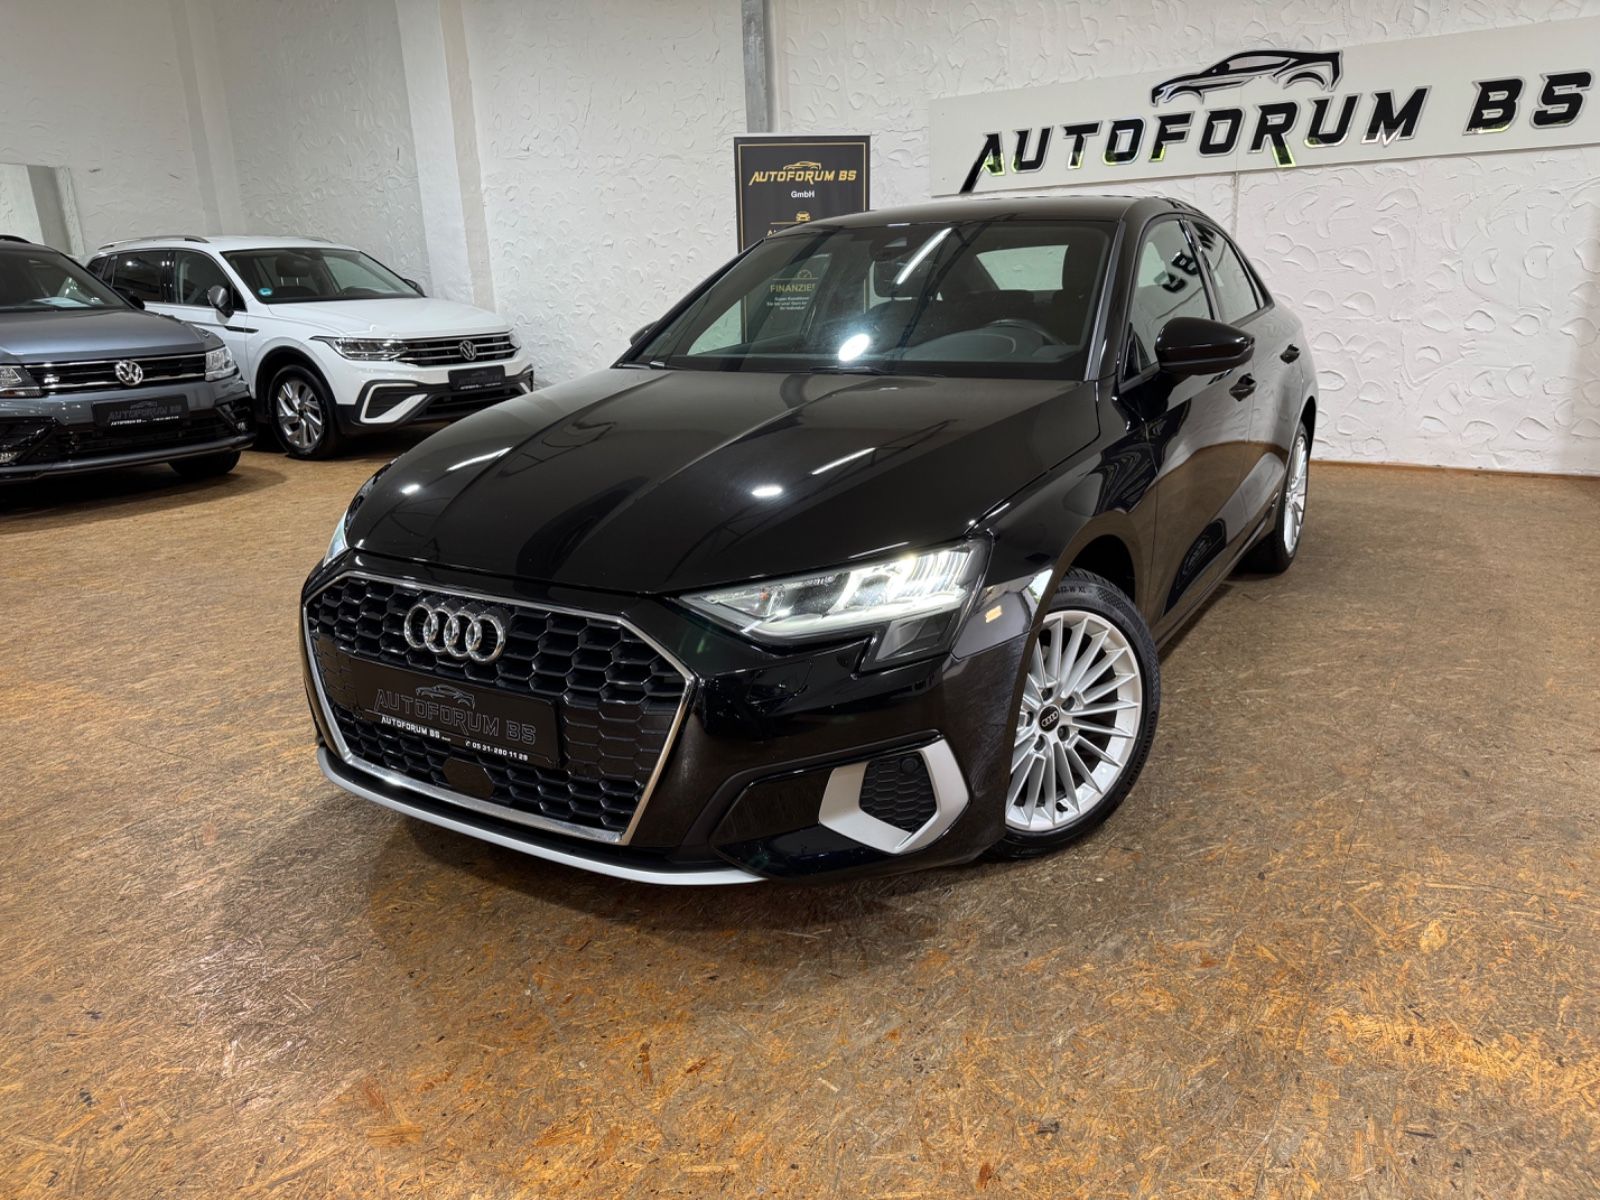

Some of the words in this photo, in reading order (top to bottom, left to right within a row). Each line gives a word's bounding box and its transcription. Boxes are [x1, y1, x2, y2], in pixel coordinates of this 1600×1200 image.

[959, 85, 1432, 194] AUTOFORUM
[1462, 69, 1594, 136] BS
[749, 170, 835, 186] AUTOFORUM
[838, 170, 857, 181] BS
[790, 190, 815, 198] GmbH
[374, 689, 499, 737] AUTOFORUM
[506, 720, 536, 745] BS
[381, 716, 428, 735] AUTOFORUM
